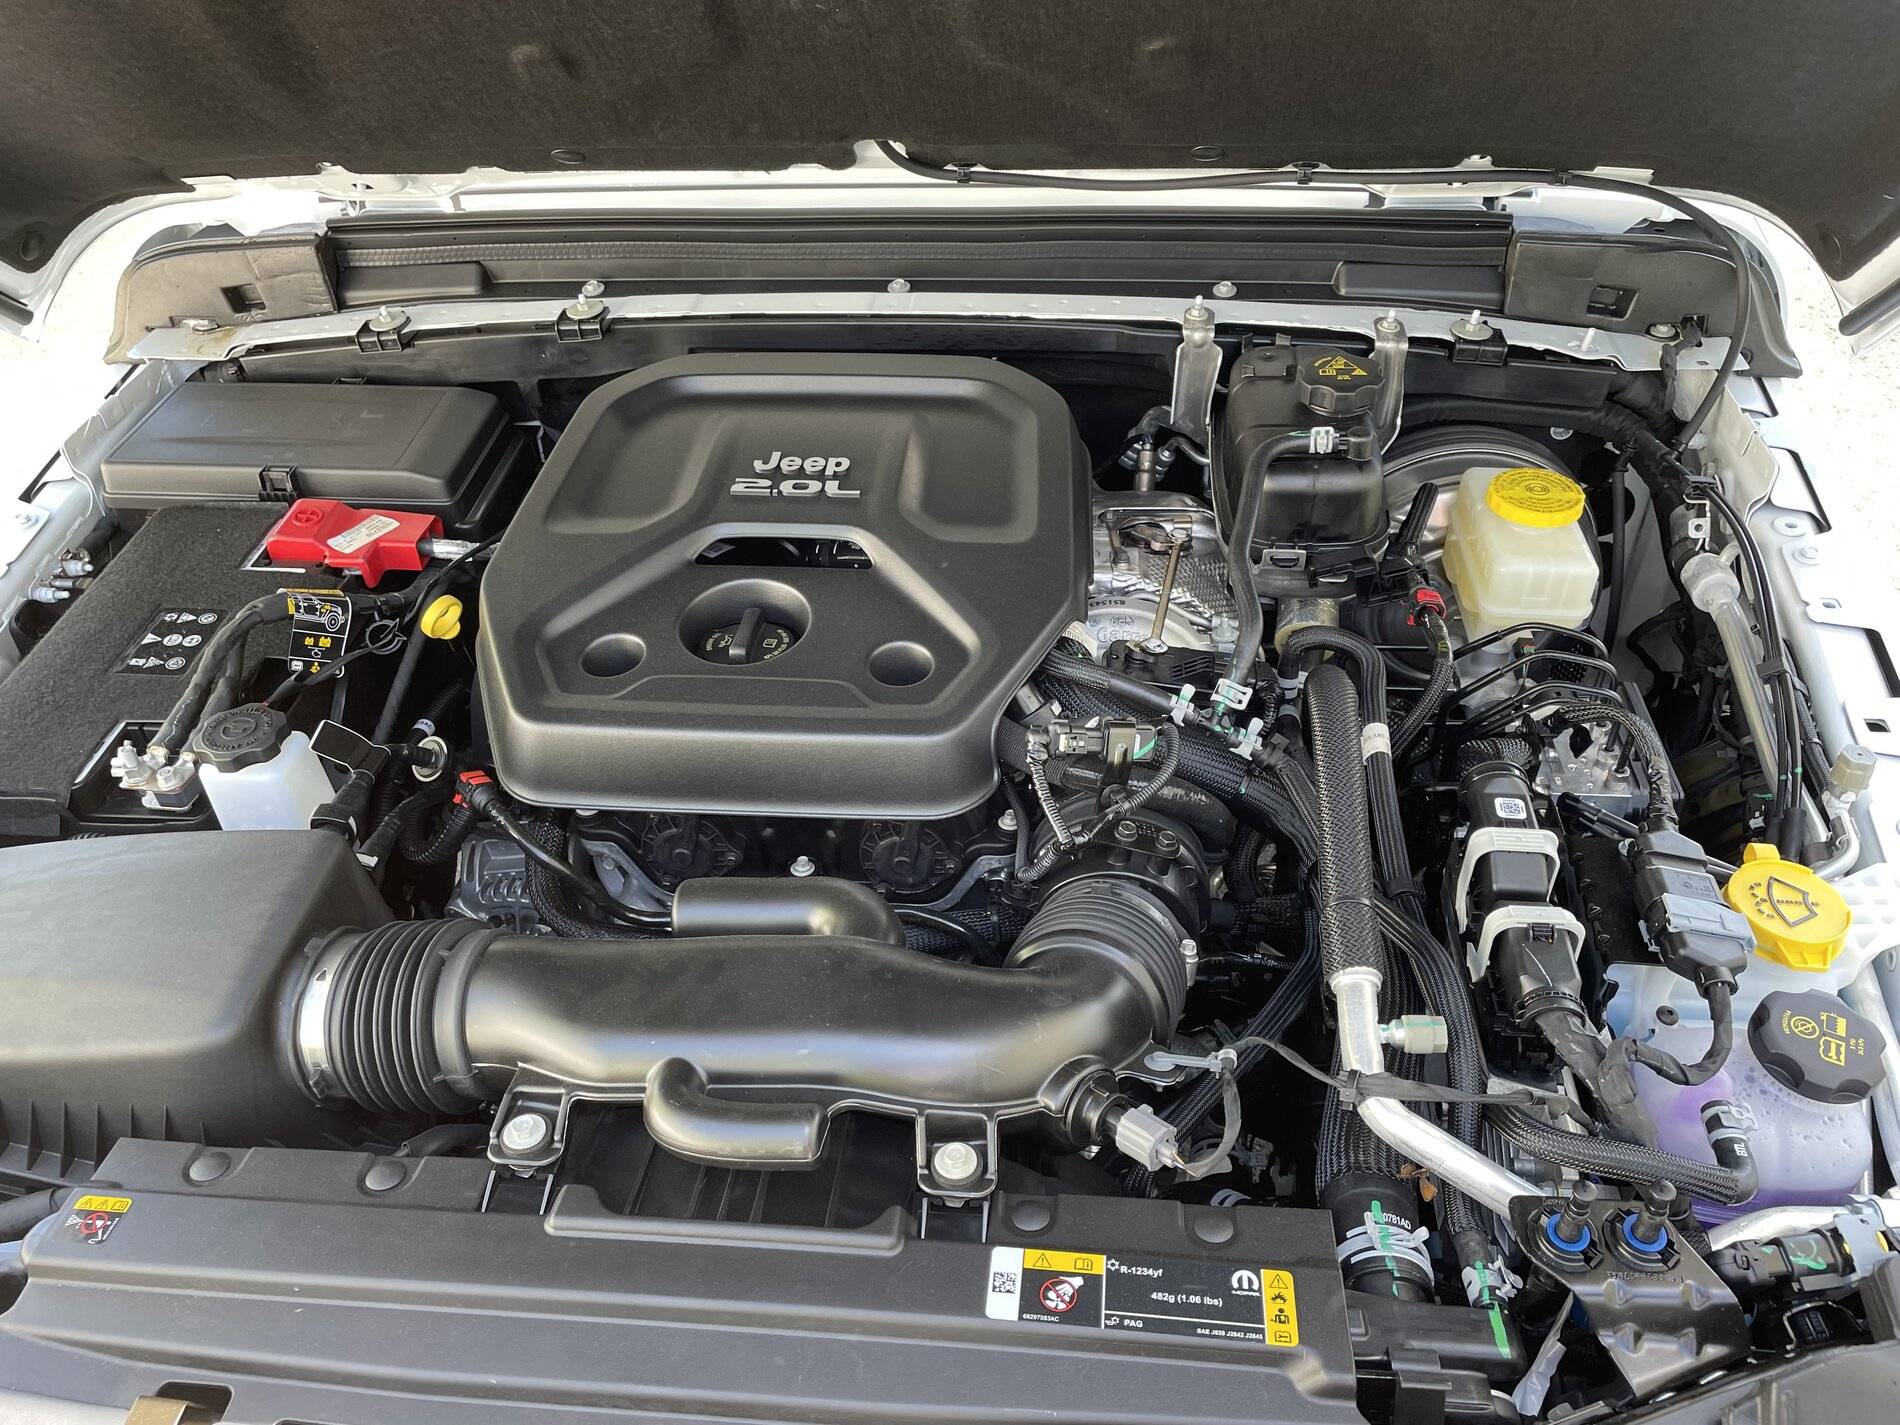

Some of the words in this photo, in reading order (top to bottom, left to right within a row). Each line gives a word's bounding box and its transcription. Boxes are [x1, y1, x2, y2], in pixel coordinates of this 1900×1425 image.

[753, 451, 851, 478] Jeep
[729, 477, 861, 498] 2.0L
[1733, 1142, 1748, 1157] BTL
[1119, 1265, 1163, 1278] R-1234yf
[1151, 1291, 1175, 1304] 482g
[1177, 1293, 1202, 1304] (1.06
[1204, 1295, 1223, 1308] lbs)
[1123, 1318, 1144, 1329] PAG
[1196, 1327, 1210, 1335] SAE
